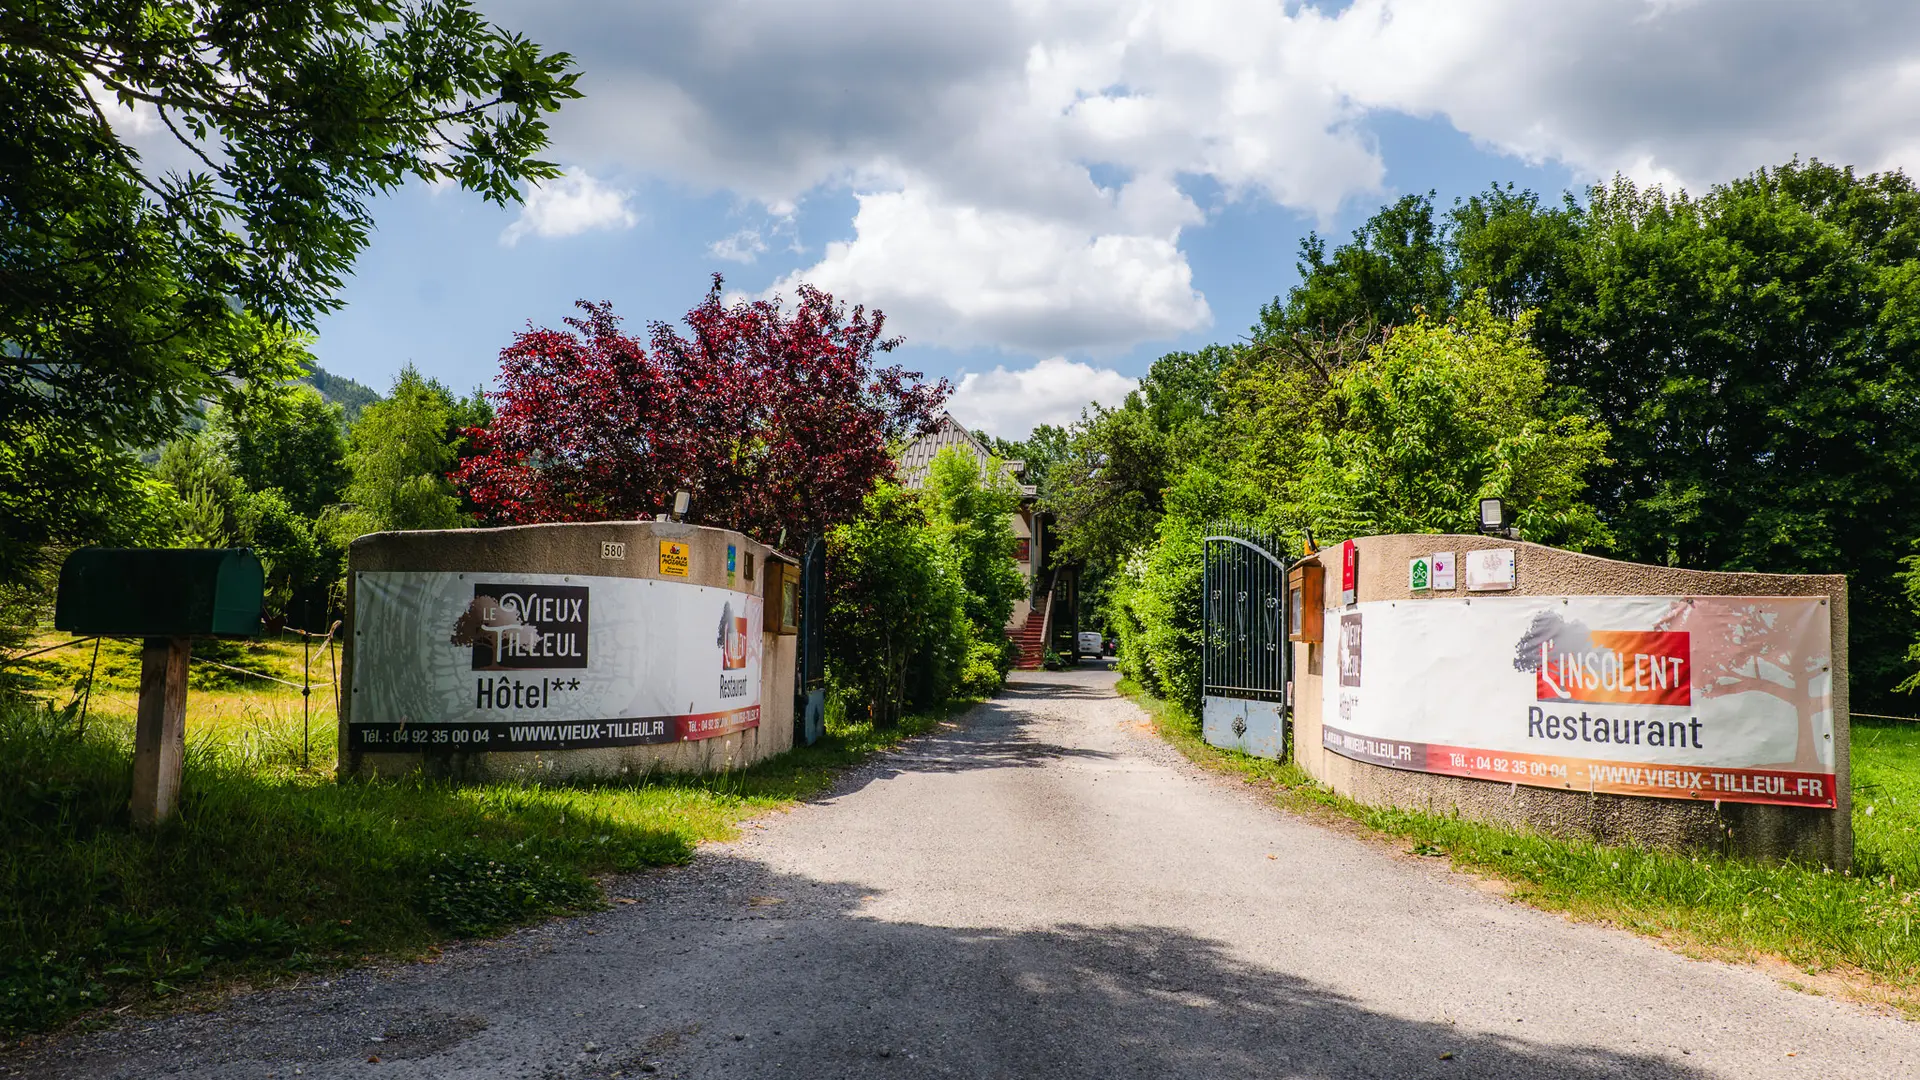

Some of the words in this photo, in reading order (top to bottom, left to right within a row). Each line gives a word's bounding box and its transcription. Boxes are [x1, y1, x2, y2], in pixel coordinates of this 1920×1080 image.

[604, 545, 622, 557] 580
[1348, 549, 1353, 567] H
[483, 607, 496, 621] LE
[500, 592, 582, 623] VIEUX
[481, 624, 581, 663] TILLEUL
[1541, 638, 1684, 699] L'INSOLENT
[720, 674, 747, 699] Restaurant
[393, 730, 408, 743] 04
[412, 730, 428, 743] 92
[432, 730, 448, 743] 35
[452, 730, 469, 743] 00
[472, 729, 489, 743] 04
[509, 720, 664, 742] WWW.VIEUX-TILLEUL.FR
[1528, 706, 1703, 749] Restaurant
[1477, 756, 1491, 770] 04
[1494, 758, 1508, 773] 92
[1511, 760, 1526, 774] 35
[1530, 762, 1546, 776] 00
[1550, 764, 1568, 778] 04
[1588, 764, 1823, 797] WWW.VIEUX-TILLEUL.FR
